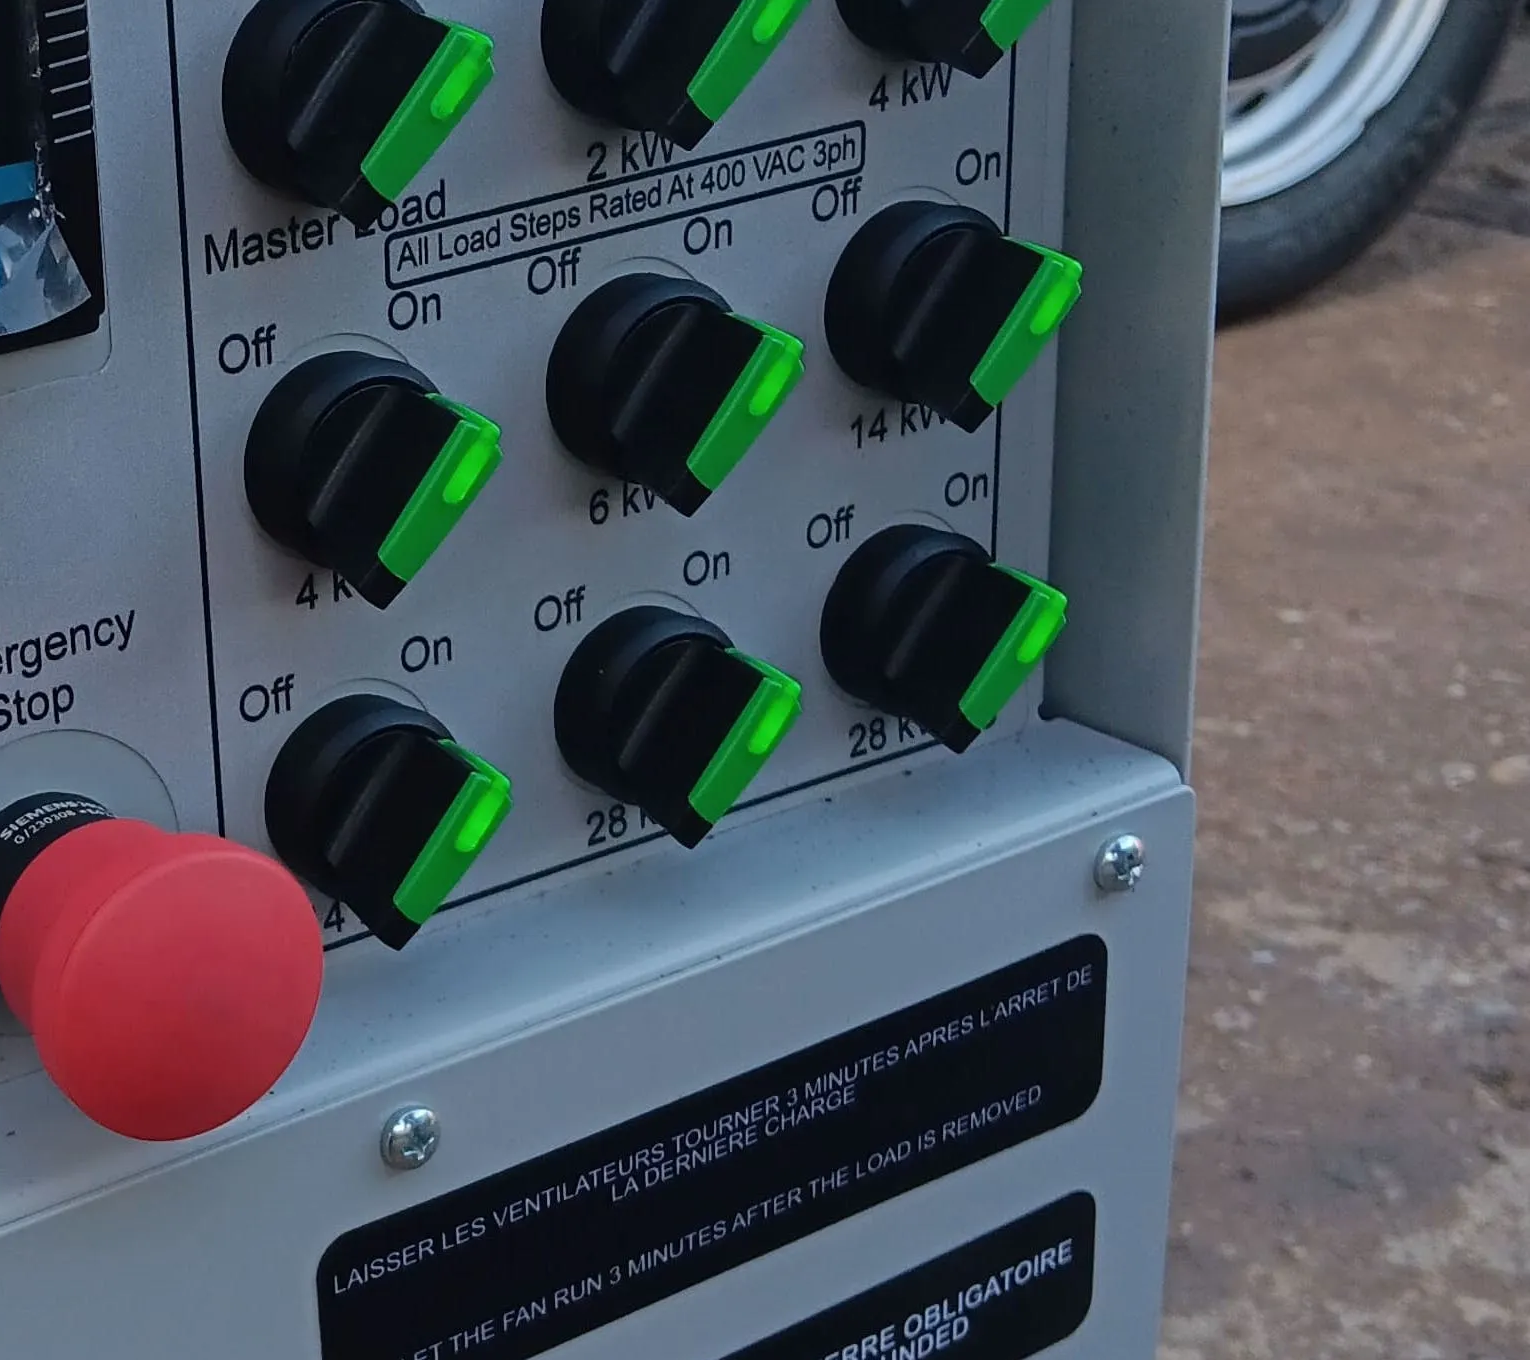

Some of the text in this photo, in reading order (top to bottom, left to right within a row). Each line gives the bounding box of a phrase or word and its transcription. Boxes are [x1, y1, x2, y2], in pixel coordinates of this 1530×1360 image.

[869, 64, 952, 111] 4 kW
[586, 141, 607, 181] 2
[955, 148, 1002, 186] On
[396, 134, 856, 271] All Load Steps Rated At 400 VAC 3ph
[812, 177, 863, 222] Off
[204, 214, 340, 275] Master
[683, 217, 732, 256] On
[527, 249, 581, 296] Off
[388, 291, 442, 331] On
[218, 325, 277, 374] Off
[851, 407, 888, 448] 14
[589, 488, 609, 525] 6
[944, 472, 988, 508] On
[806, 505, 855, 549] Off
[683, 550, 730, 587] On
[296, 574, 319, 610] 4
[534, 587, 586, 632] Off
[401, 636, 453, 673] On
[239, 674, 295, 723] Off
[849, 715, 887, 758] 28
[0, 801, 78, 840] SIEMENS
[587, 804, 627, 846] 28
[333, 963, 1093, 1295] LAISSER LES VENTILATEURS TOURNER 3 MINUTES APRES L'ARRET DE
[610, 1084, 857, 1202] LA DERNIERE CHARGE
[449, 1319, 496, 1355] THE
[502, 1296, 547, 1334] FAN
[553, 1273, 603, 1310] RUN
[609, 1265, 622, 1287] 3
[628, 1220, 727, 1278] MINUTES
[731, 1187, 803, 1233] AFTER
[808, 1166, 850, 1199] THE
[856, 1140, 911, 1180] LOAD
[918, 1129, 937, 1152] IS
[942, 1084, 1042, 1142] REMOVED
[903, 1238, 1073, 1339] OBLIGATOIRE
